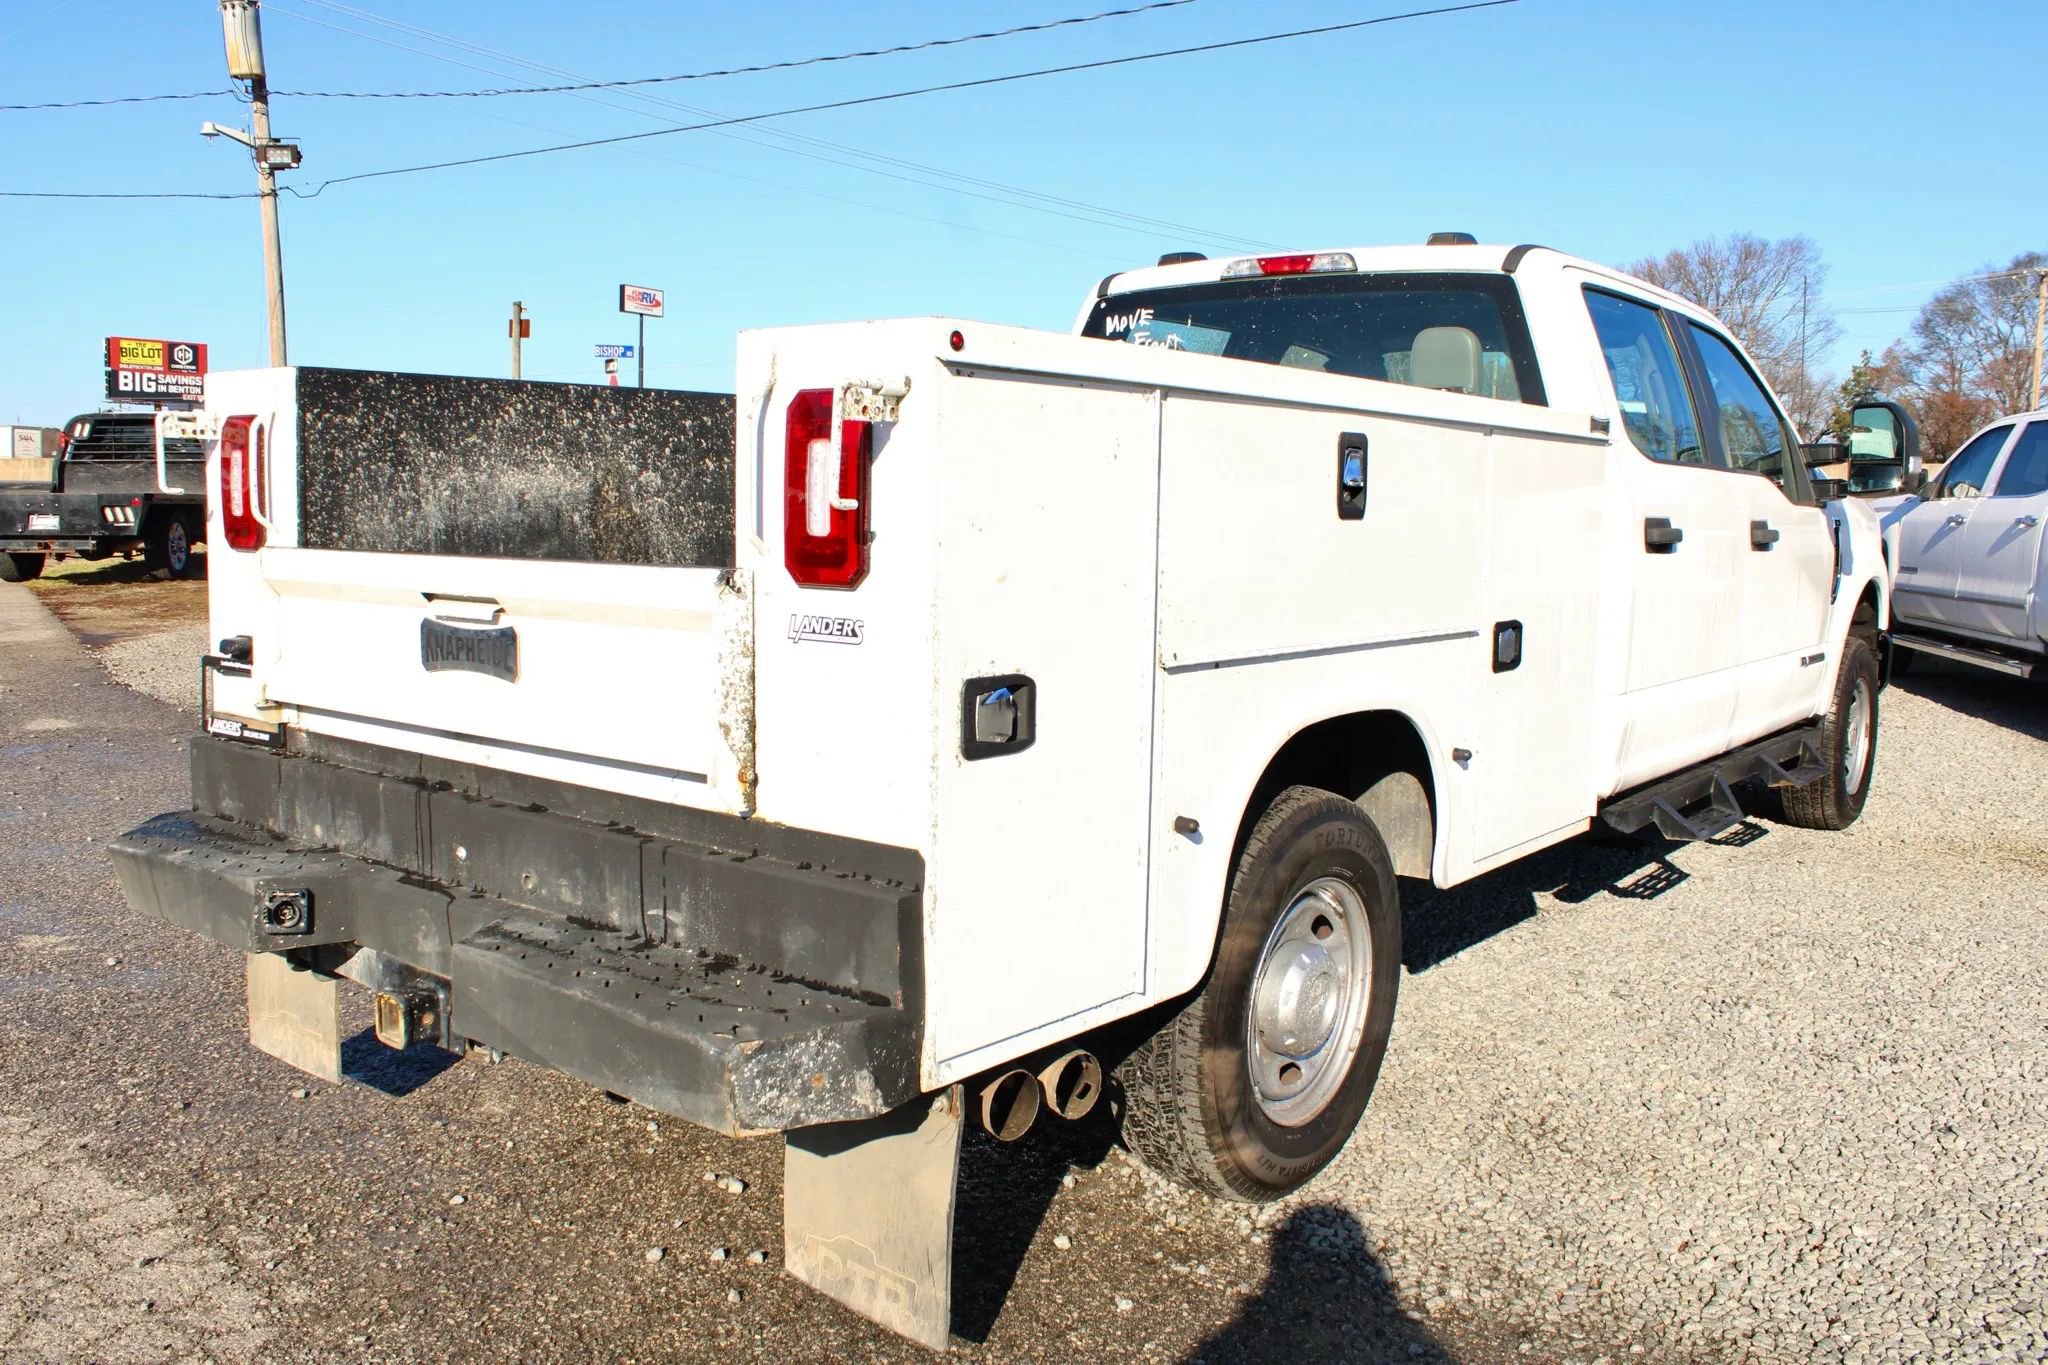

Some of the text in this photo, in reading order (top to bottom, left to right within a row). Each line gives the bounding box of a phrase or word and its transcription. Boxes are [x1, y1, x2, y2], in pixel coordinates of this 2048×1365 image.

[642, 292, 656, 304] RV
[1106, 308, 1154, 336] MOVE
[120, 347, 163, 359] BIG LOT
[595, 346, 624, 356] BISHOP
[119, 371, 203, 393] BIG SAVINGS
[157, 384, 202, 395] IN BENTON
[787, 613, 864, 646] LANDERS
[207, 717, 242, 737] LANDERS
